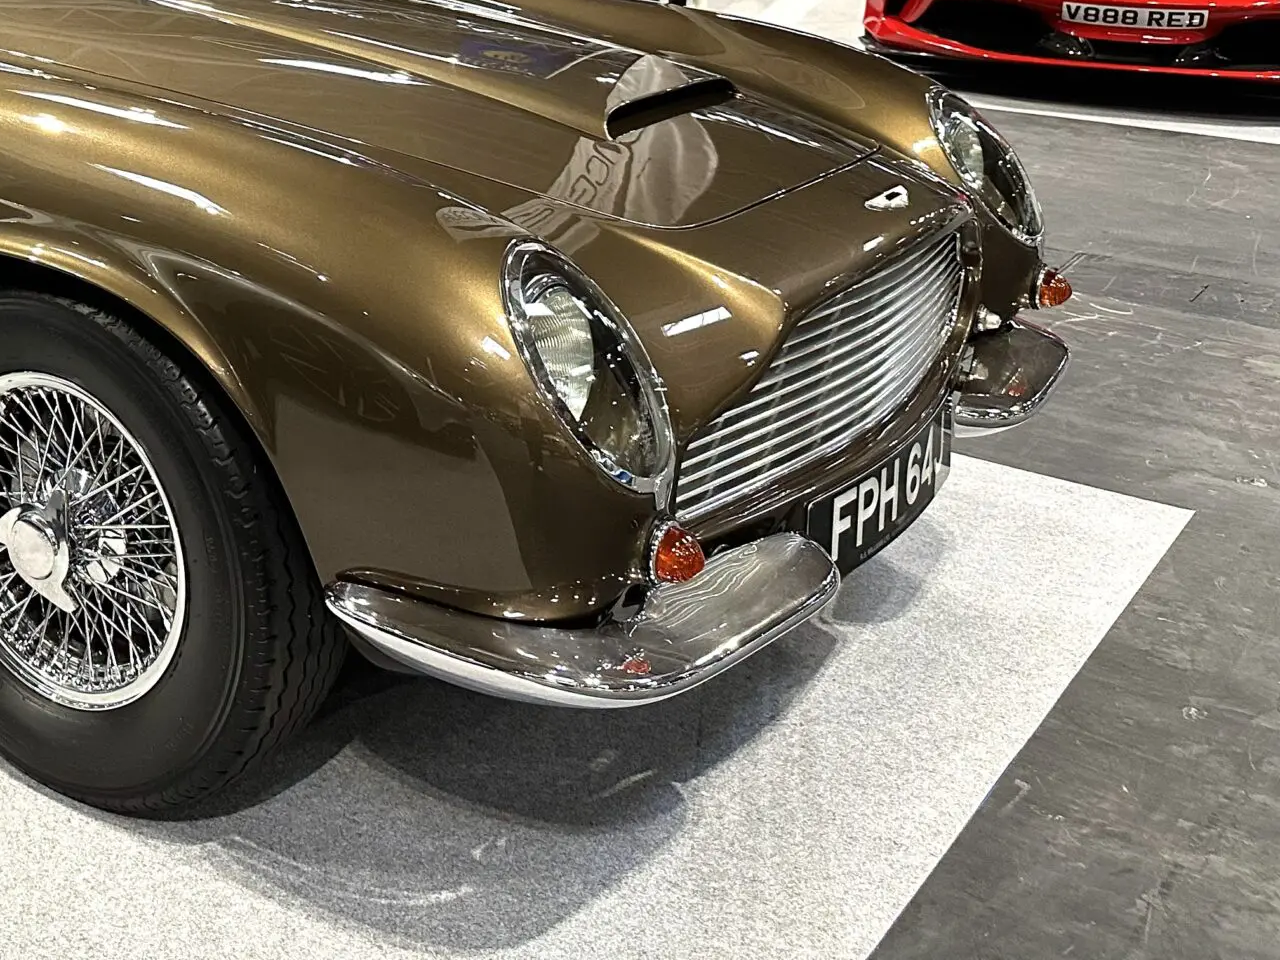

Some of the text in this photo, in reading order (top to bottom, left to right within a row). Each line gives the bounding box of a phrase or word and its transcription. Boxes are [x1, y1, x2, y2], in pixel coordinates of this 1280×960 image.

[1065, 4, 1206, 28] V888 RED
[830, 457, 901, 562] FPH
